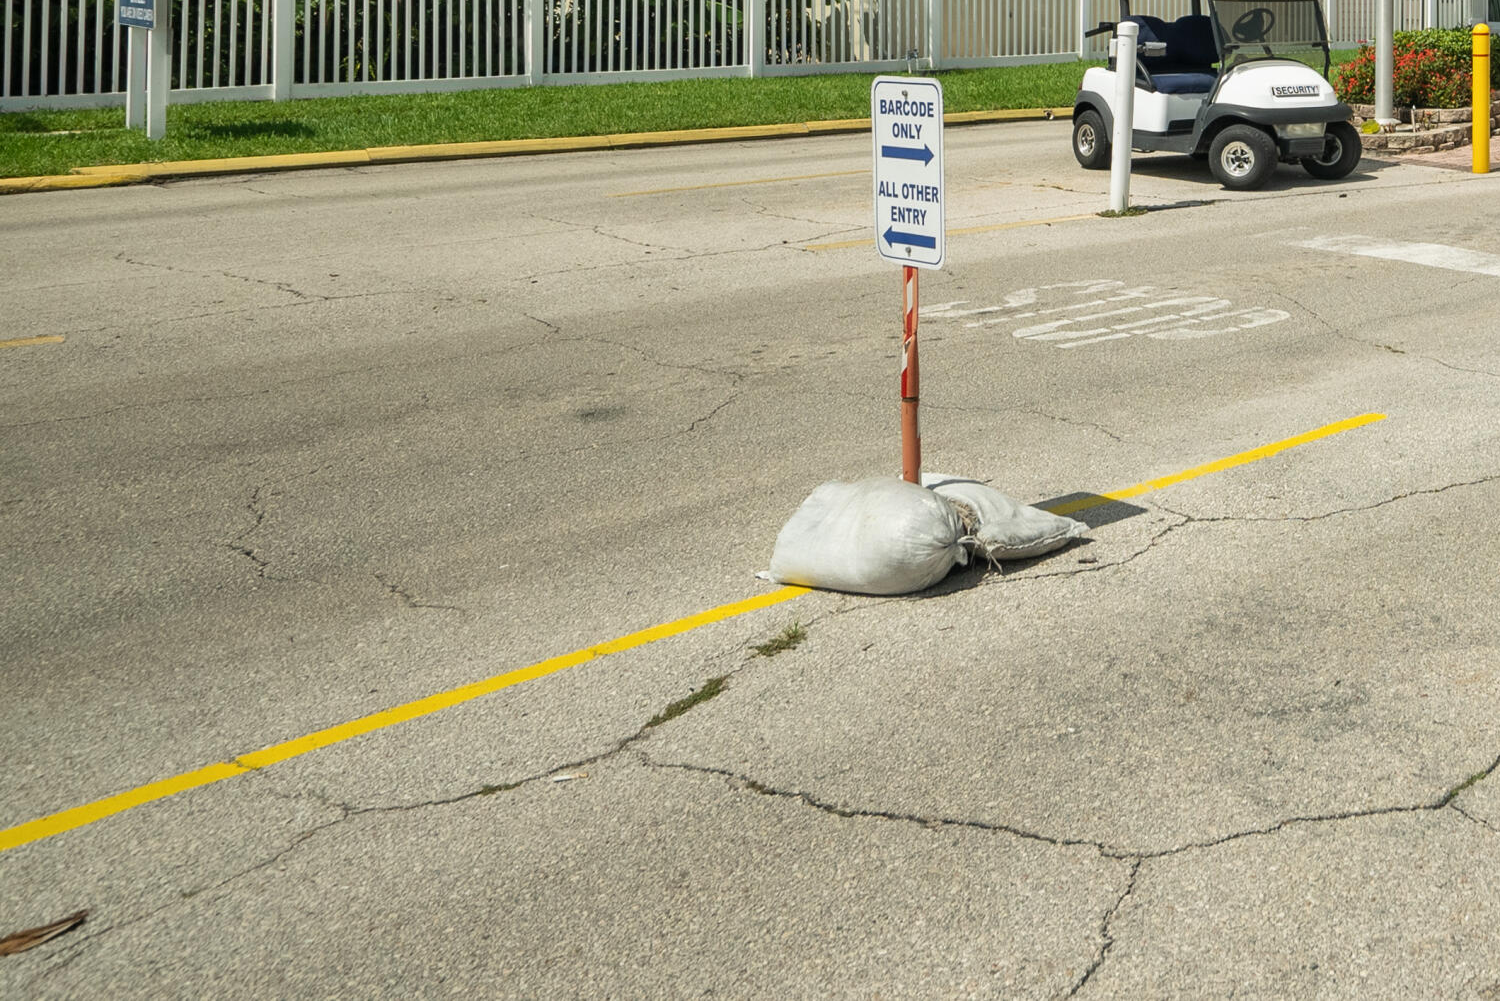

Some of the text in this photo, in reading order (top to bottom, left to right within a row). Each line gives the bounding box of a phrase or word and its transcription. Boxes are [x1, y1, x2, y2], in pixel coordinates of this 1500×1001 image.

[1275, 85, 1316, 94] SECURITY
[879, 99, 935, 118] BARCODE
[892, 122, 922, 140] ONLY
[878, 181, 939, 204] ALL OTHER
[891, 206, 927, 226] ENTRY
